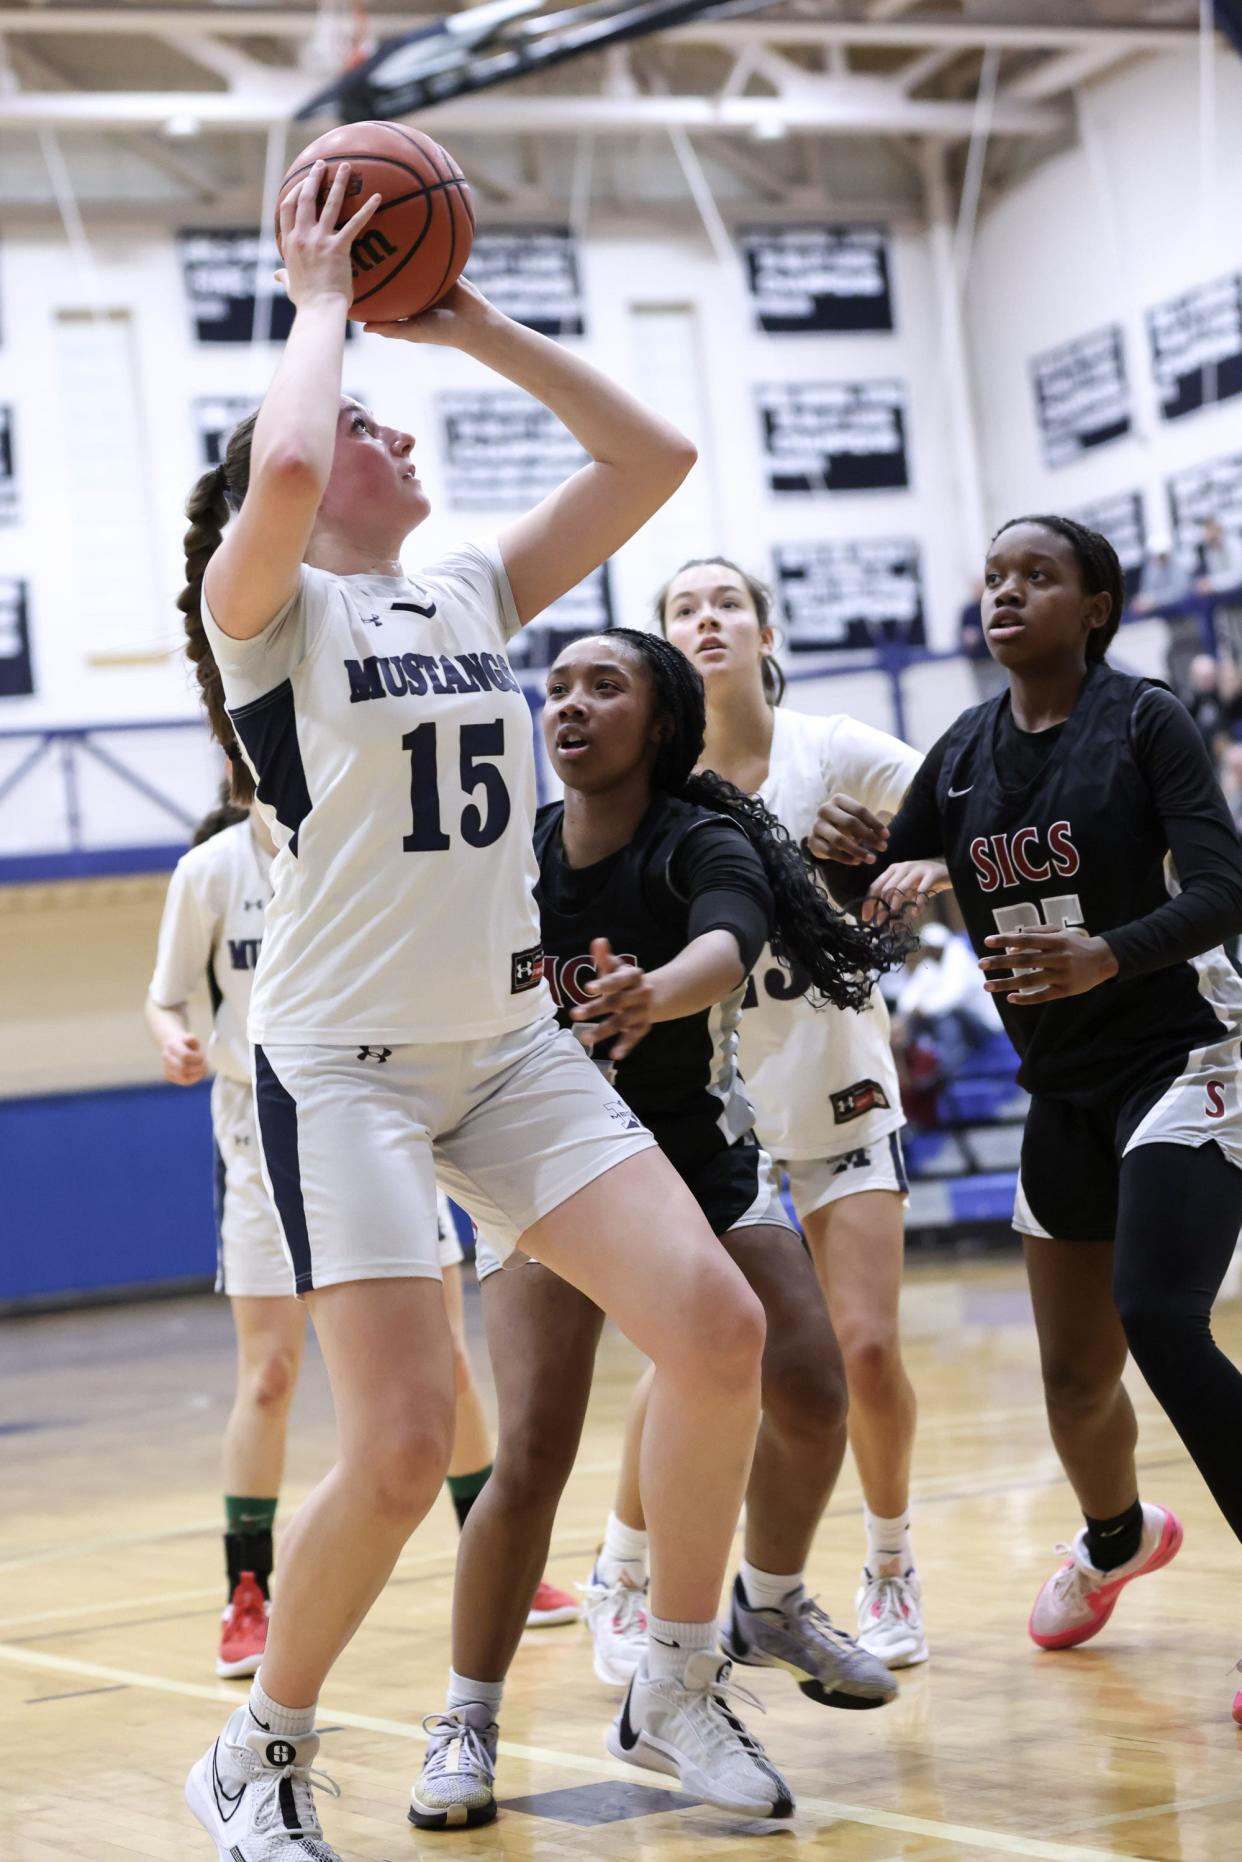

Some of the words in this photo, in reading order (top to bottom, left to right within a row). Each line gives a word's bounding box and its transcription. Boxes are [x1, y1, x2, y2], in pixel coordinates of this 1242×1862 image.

[402, 718, 511, 852] 15
[970, 820, 1080, 893] SICS
[1204, 1079, 1225, 1119] S
